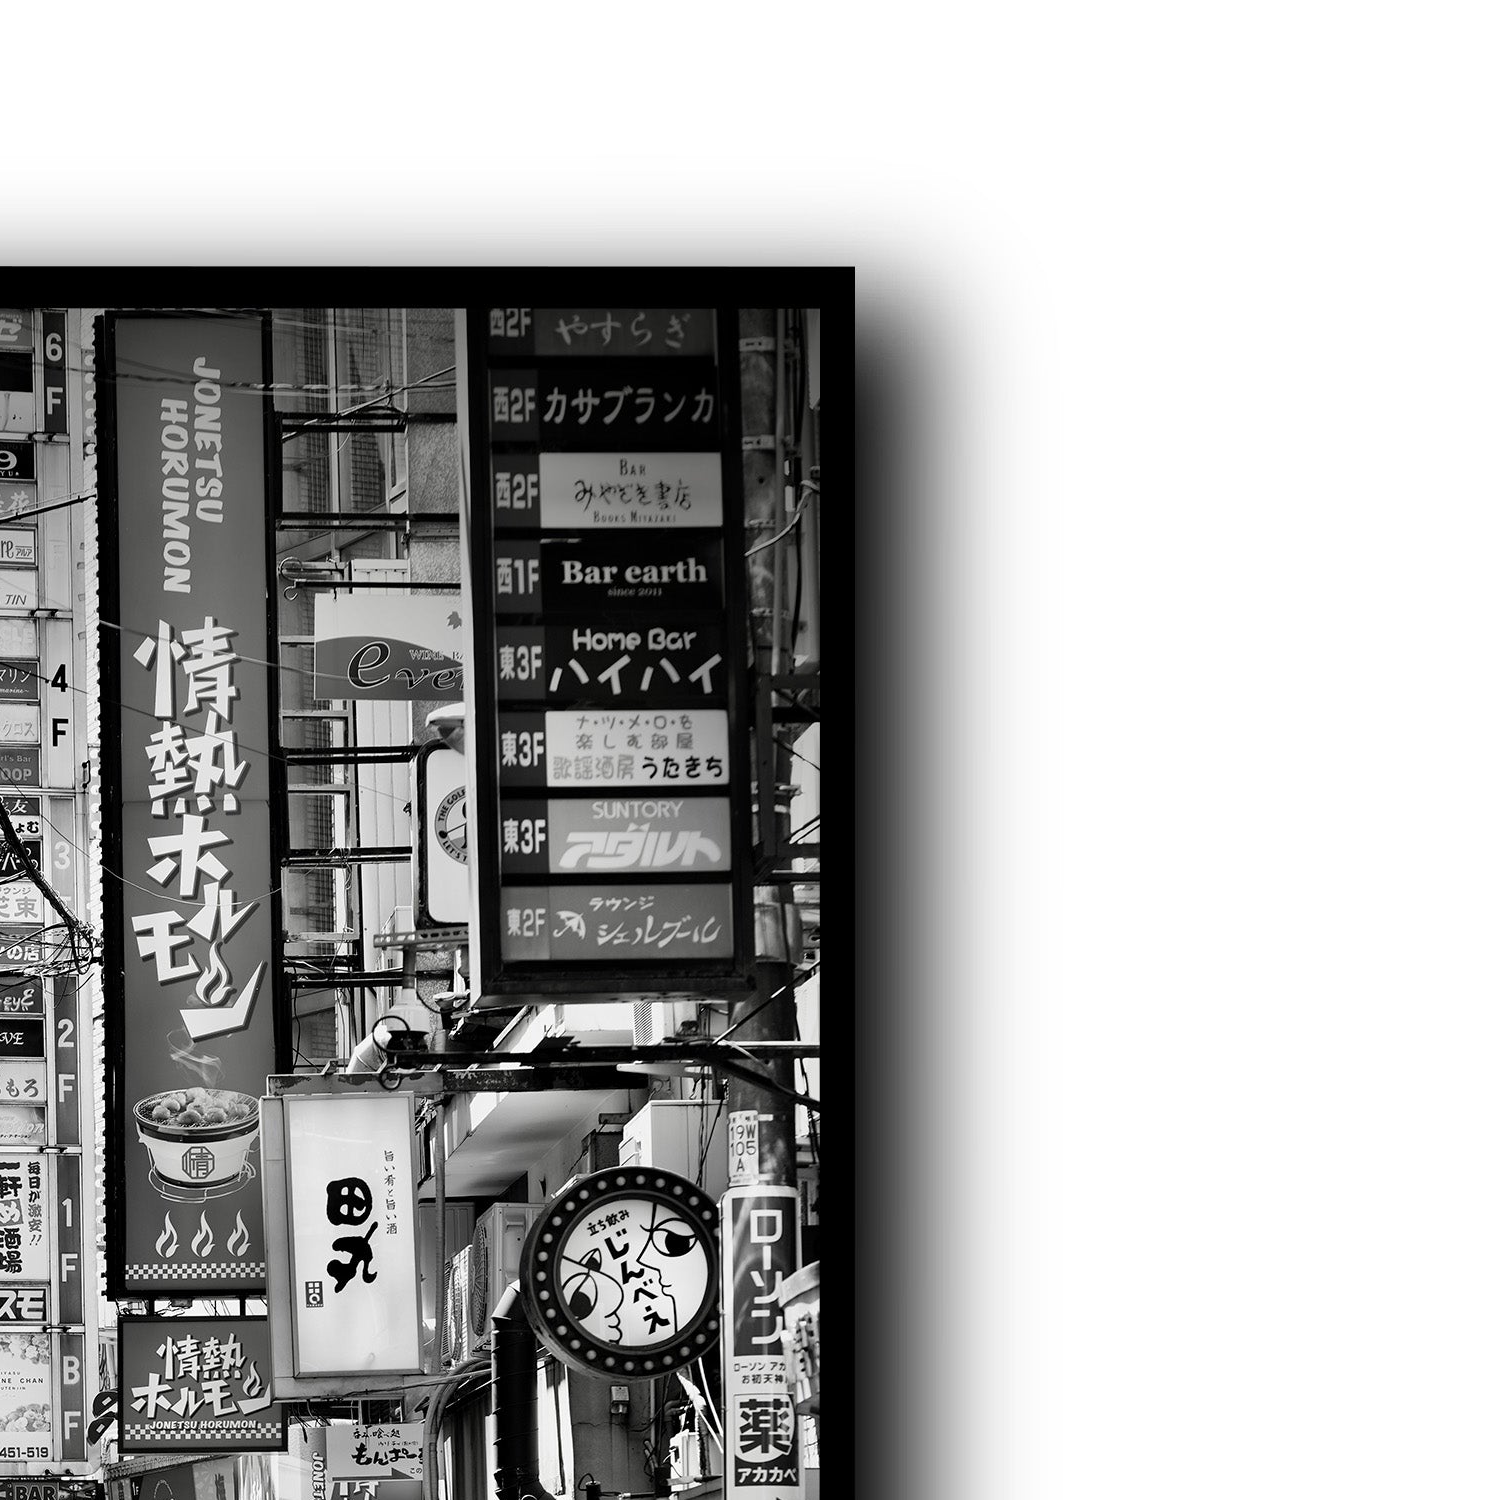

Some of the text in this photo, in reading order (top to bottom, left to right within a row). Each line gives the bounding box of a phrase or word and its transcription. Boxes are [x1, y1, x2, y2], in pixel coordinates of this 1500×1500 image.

[555, 311, 691, 348] やすらぎ
[543, 385, 714, 425] カサブランカ
[192, 357, 223, 523] JONETSU
[160, 398, 192, 594] HORUMON
[562, 560, 618, 584] Bar
[624, 557, 709, 583] earth
[5, 594, 26, 604] TIN
[573, 627, 697, 651] Home Bar
[499, 646, 722, 695] 東3F ハイハイ
[501, 731, 544, 767] 東3F
[641, 755, 724, 779] うたきち
[575, 734, 694, 750] 楽しむ部屋
[592, 801, 684, 819] SUNTORY
[132, 614, 268, 1043] 情熱ホルモン
[503, 819, 546, 854] 東3F
[589, 896, 655, 911] ラウンジ
[507, 908, 546, 937] 東2F
[730, 1141, 756, 1156] 105
[736, 1158, 745, 1172] A
[586, 1209, 631, 1236] 立ち飲み
[750, 1209, 783, 1345] ローソン
[156, 1332, 247, 1380] 情熱
[734, 1363, 764, 1372] ローソン
[131, 1361, 271, 1419] ホルモン
[742, 1373, 788, 1384] お初天神
[149, 1420, 257, 1431] JONETSU HORUMON
[739, 1398, 791, 1454] 薬
[737, 1466, 797, 1484] アカカベ
